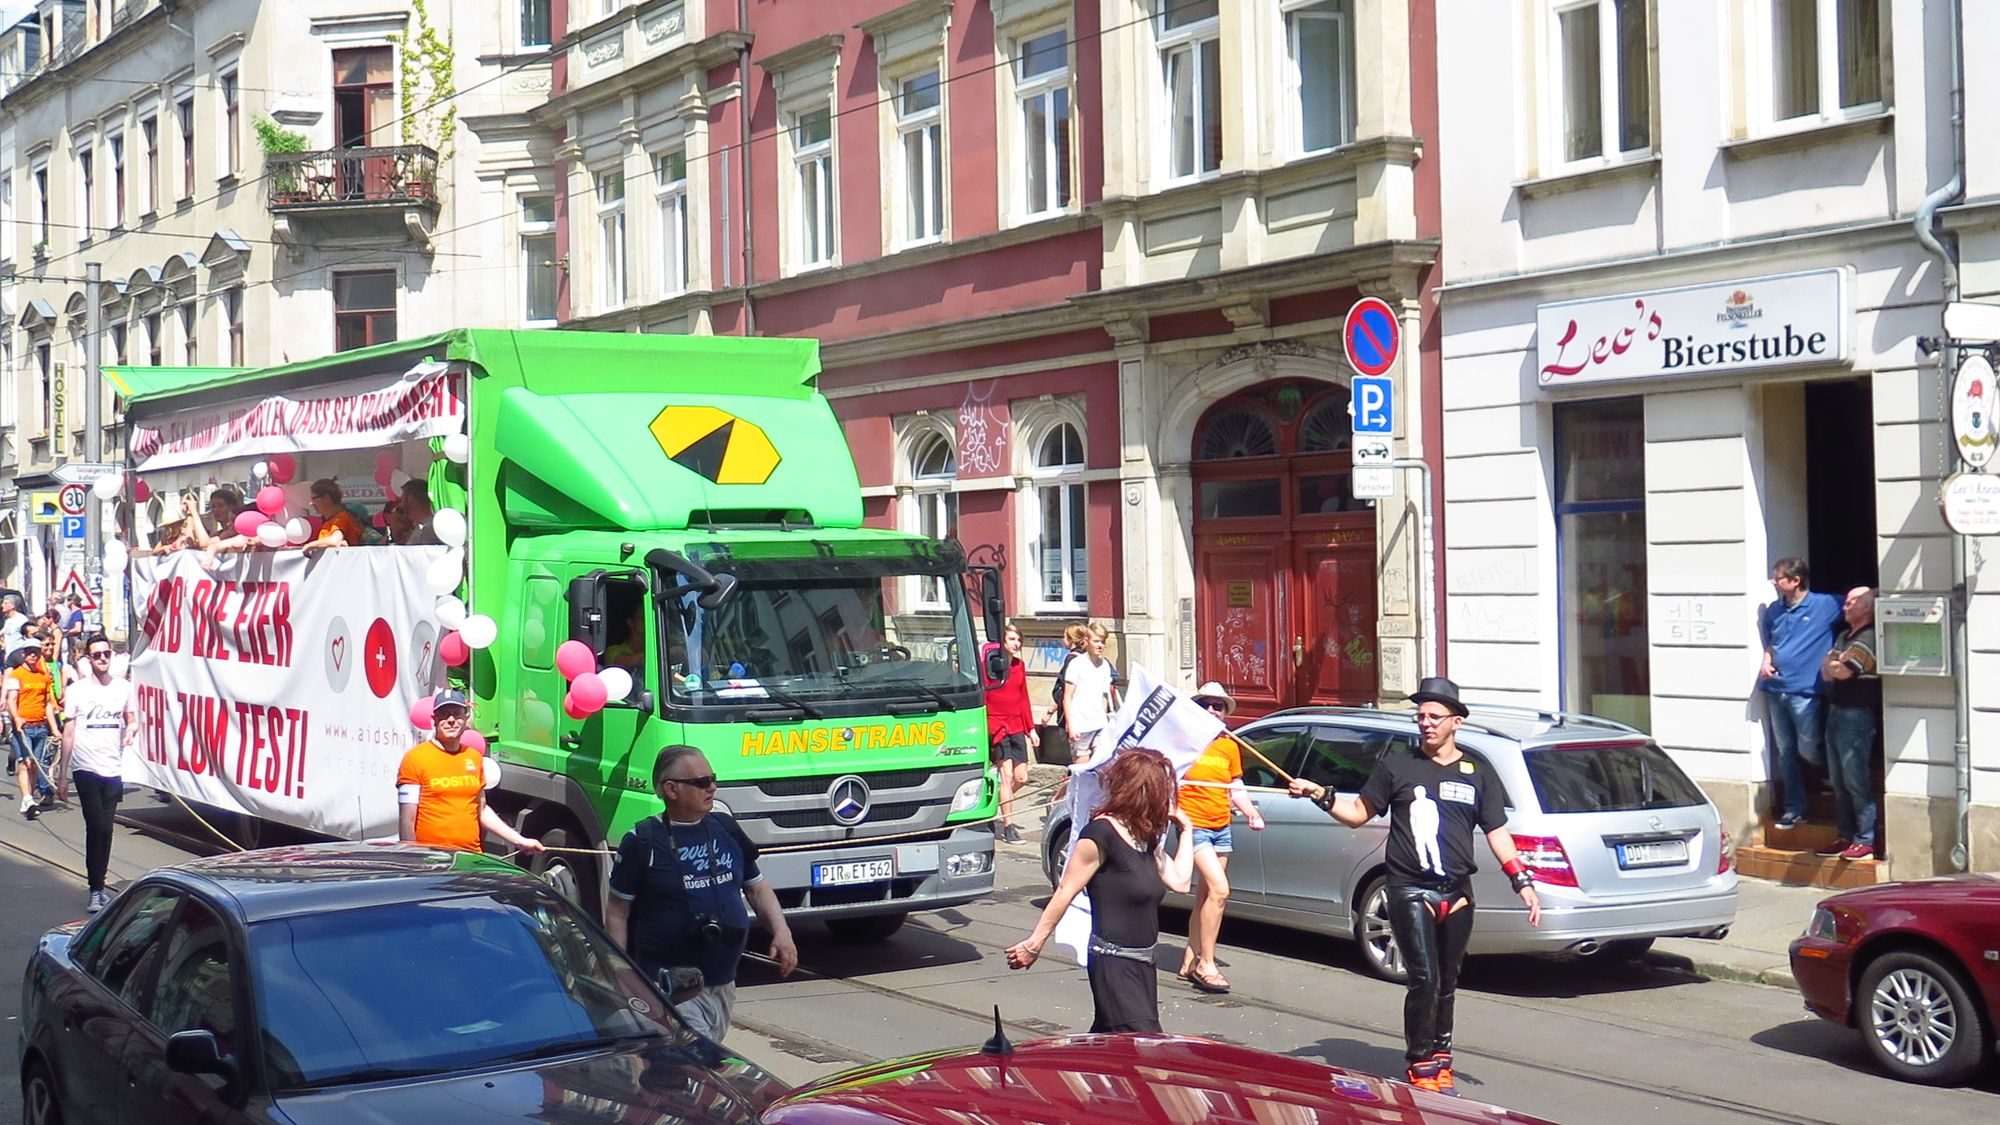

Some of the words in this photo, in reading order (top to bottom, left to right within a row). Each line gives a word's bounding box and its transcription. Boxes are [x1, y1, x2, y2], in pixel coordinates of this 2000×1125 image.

[1541, 298, 1662, 382] Leo's
[1662, 324, 1827, 370] Bierstube
[54, 362, 65, 454] HOSTEL
[290, 397, 331, 436] DASS
[329, 395, 358, 436] SEX
[1361, 384, 1384, 426] P
[65, 492, 84, 507] 30
[67, 518, 81, 537] P
[234, 581, 294, 668] EIER
[176, 691, 229, 777] ZUM
[235, 700, 308, 799] TEST!
[740, 720, 947, 758] HANSETRANS
[822, 865, 844, 882] PIR
[852, 863, 867, 880] ET
[869, 861, 891, 878] 562
